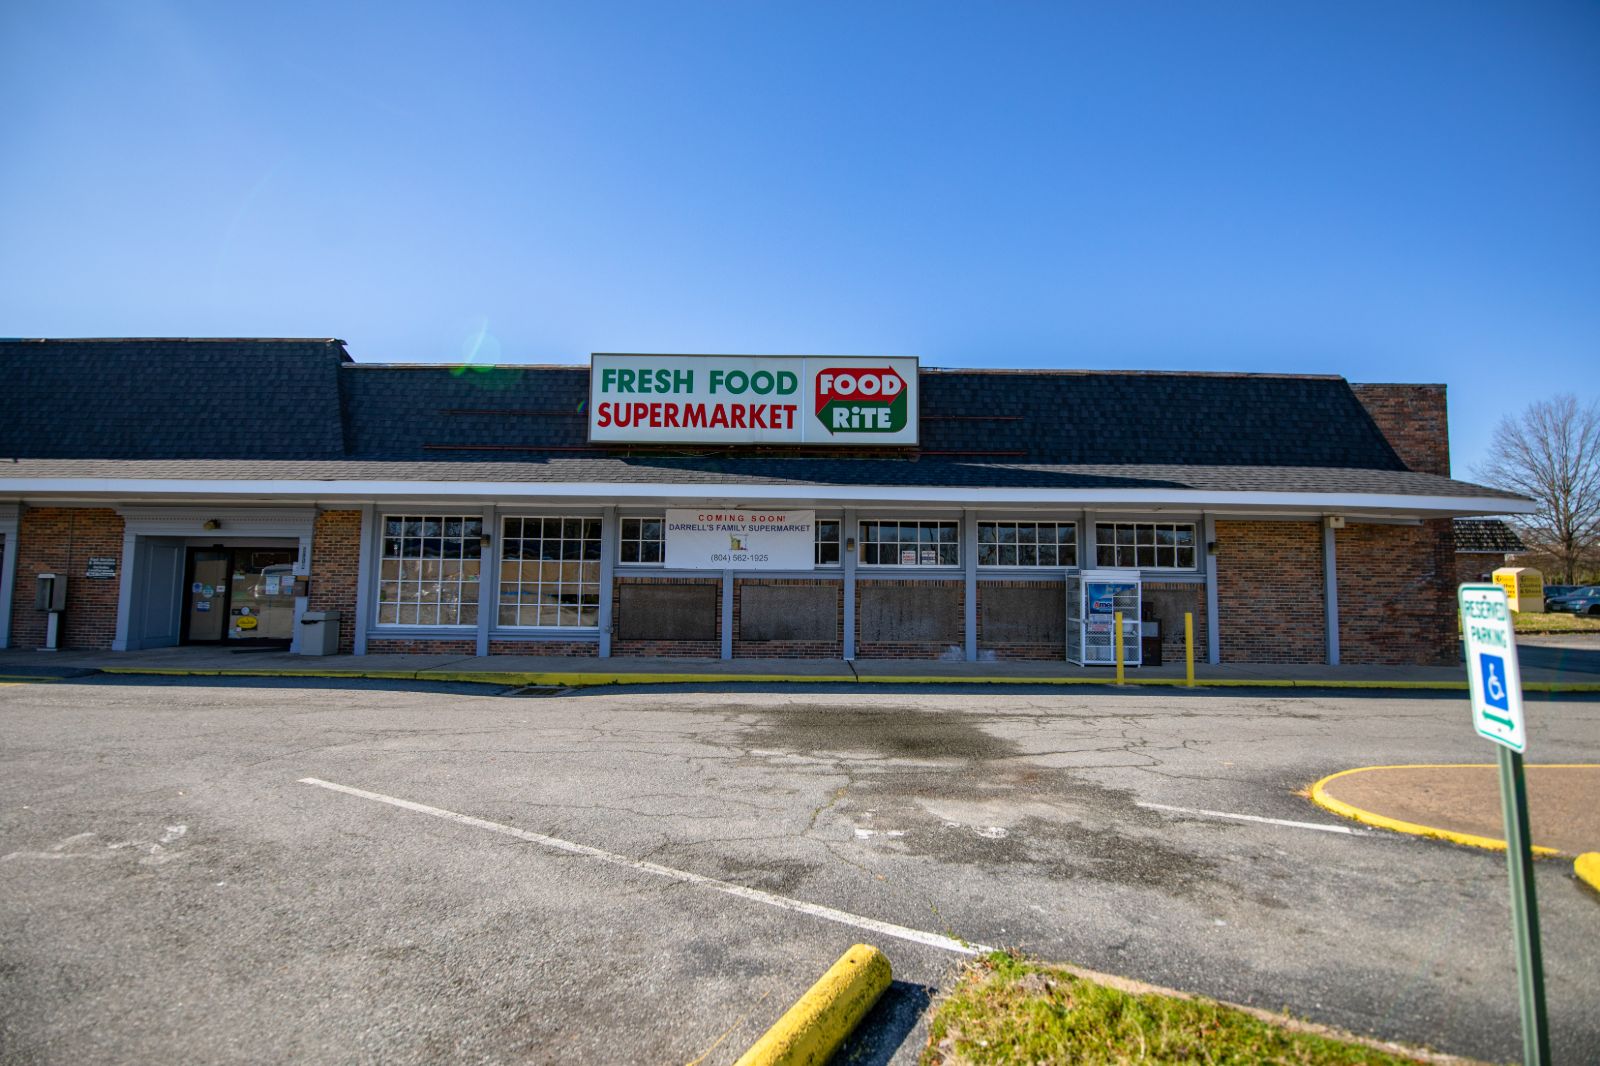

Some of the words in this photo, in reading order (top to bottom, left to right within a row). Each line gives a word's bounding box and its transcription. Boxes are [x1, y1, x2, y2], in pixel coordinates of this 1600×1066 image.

[601, 369, 694, 394] FRESH
[709, 370, 798, 395] FOOD
[820, 373, 902, 396] FOOD
[597, 402, 798, 430] SUPERMARKET
[669, 523, 714, 532] DARRELL'S
[716, 524, 746, 532] FAMILY
[748, 524, 811, 532] SUPERMARKET
[698, 514, 745, 522] COMING
[751, 515, 786, 523] SOON!
[710, 554, 731, 562] (804)
[732, 554, 769, 562] 562-1925
[1464, 600, 1506, 621] RESERVED
[1471, 625, 1507, 649] PARKING
